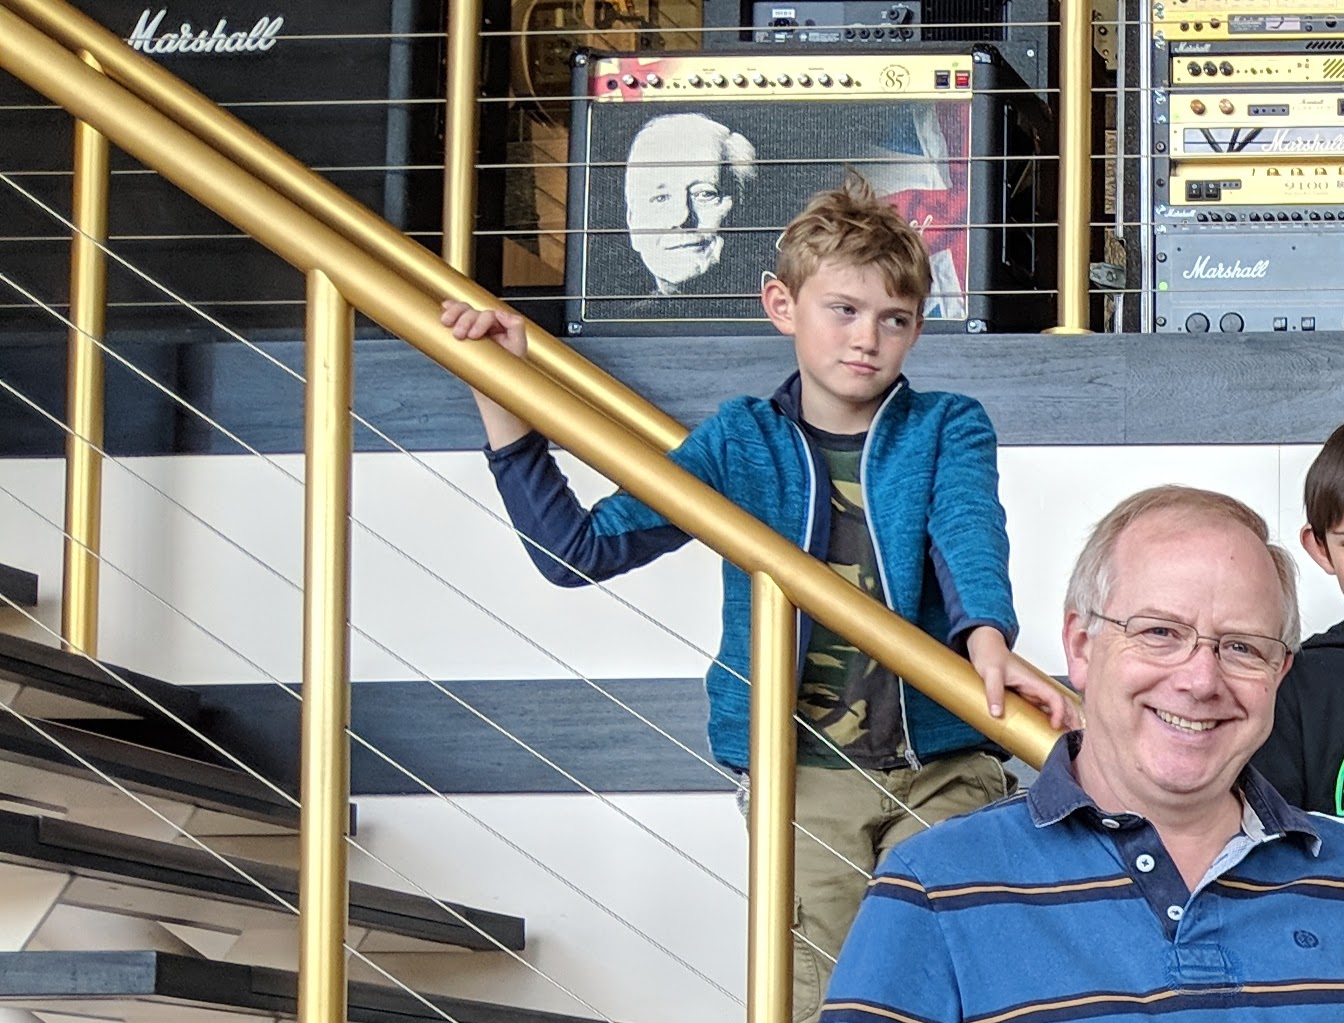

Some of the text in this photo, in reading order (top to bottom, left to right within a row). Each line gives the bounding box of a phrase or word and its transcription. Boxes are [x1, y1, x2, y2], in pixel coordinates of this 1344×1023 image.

[127, 8, 285, 54] Marshall
[885, 70, 904, 90] 85
[1183, 255, 1270, 279] Marshall
